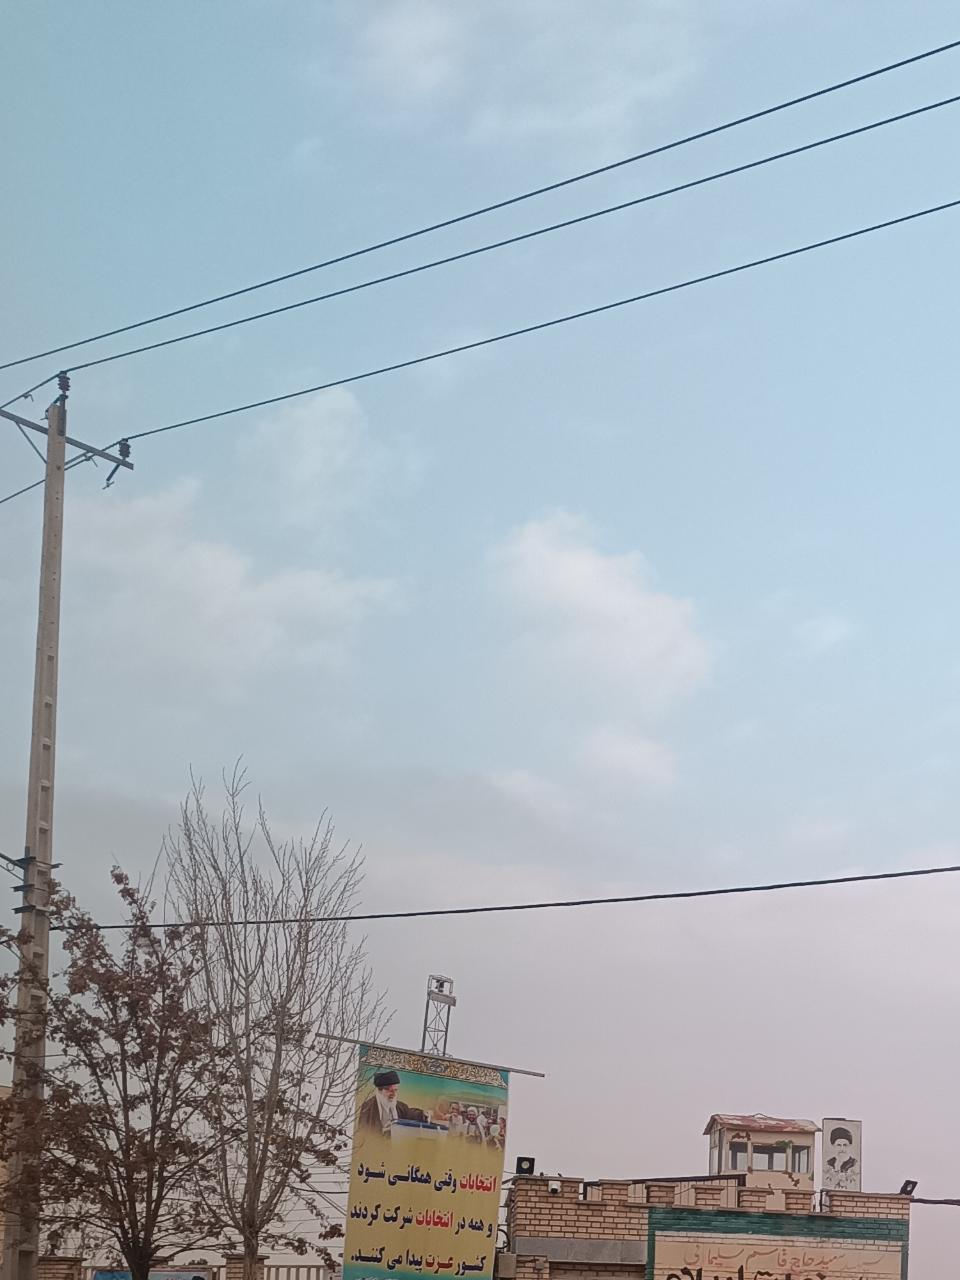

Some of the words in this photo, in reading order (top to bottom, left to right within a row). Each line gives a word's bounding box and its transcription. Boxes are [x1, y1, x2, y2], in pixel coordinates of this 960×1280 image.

[357, 1161, 386, 1182] شود
[388, 1164, 432, 1187] همگانی
[434, 1170, 457, 1194] وقتی
[459, 1172, 497, 1194] انتخابات
[350, 1203, 381, 1225] کردند
[383, 1205, 413, 1230] شرکت
[415, 1208, 453, 1229] انتخابات
[468, 1214, 485, 1232] همه
[454, 1216, 466, 1235] در
[486, 1223, 493, 1238] و
[386, 1254, 402, 1272] می
[405, 1249, 423, 1273] پیدا
[425, 1252, 454, 1274] عزت
[454, 1251, 486, 1276] کشور
[684, 1244, 744, 1268] سلیمانی
[745, 1247, 788, 1273] قاسم
[790, 1251, 814, 1276] حاج
